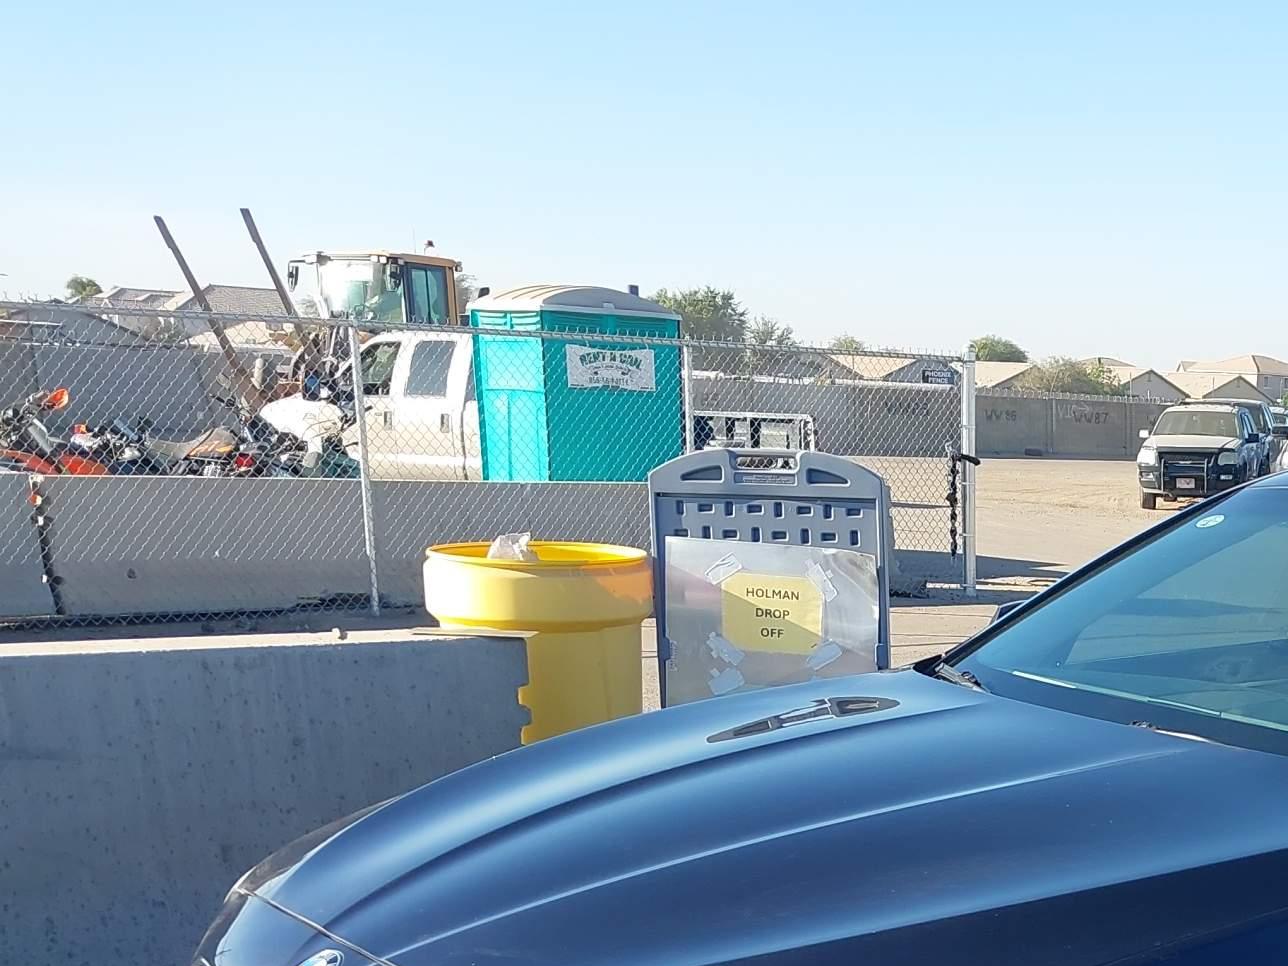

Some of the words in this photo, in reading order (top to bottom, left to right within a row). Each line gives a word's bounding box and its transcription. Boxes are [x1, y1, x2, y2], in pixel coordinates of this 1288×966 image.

[746, 588, 800, 600] HOLMAN
[755, 608, 790, 619] DROP
[760, 627, 784, 638] OFF
